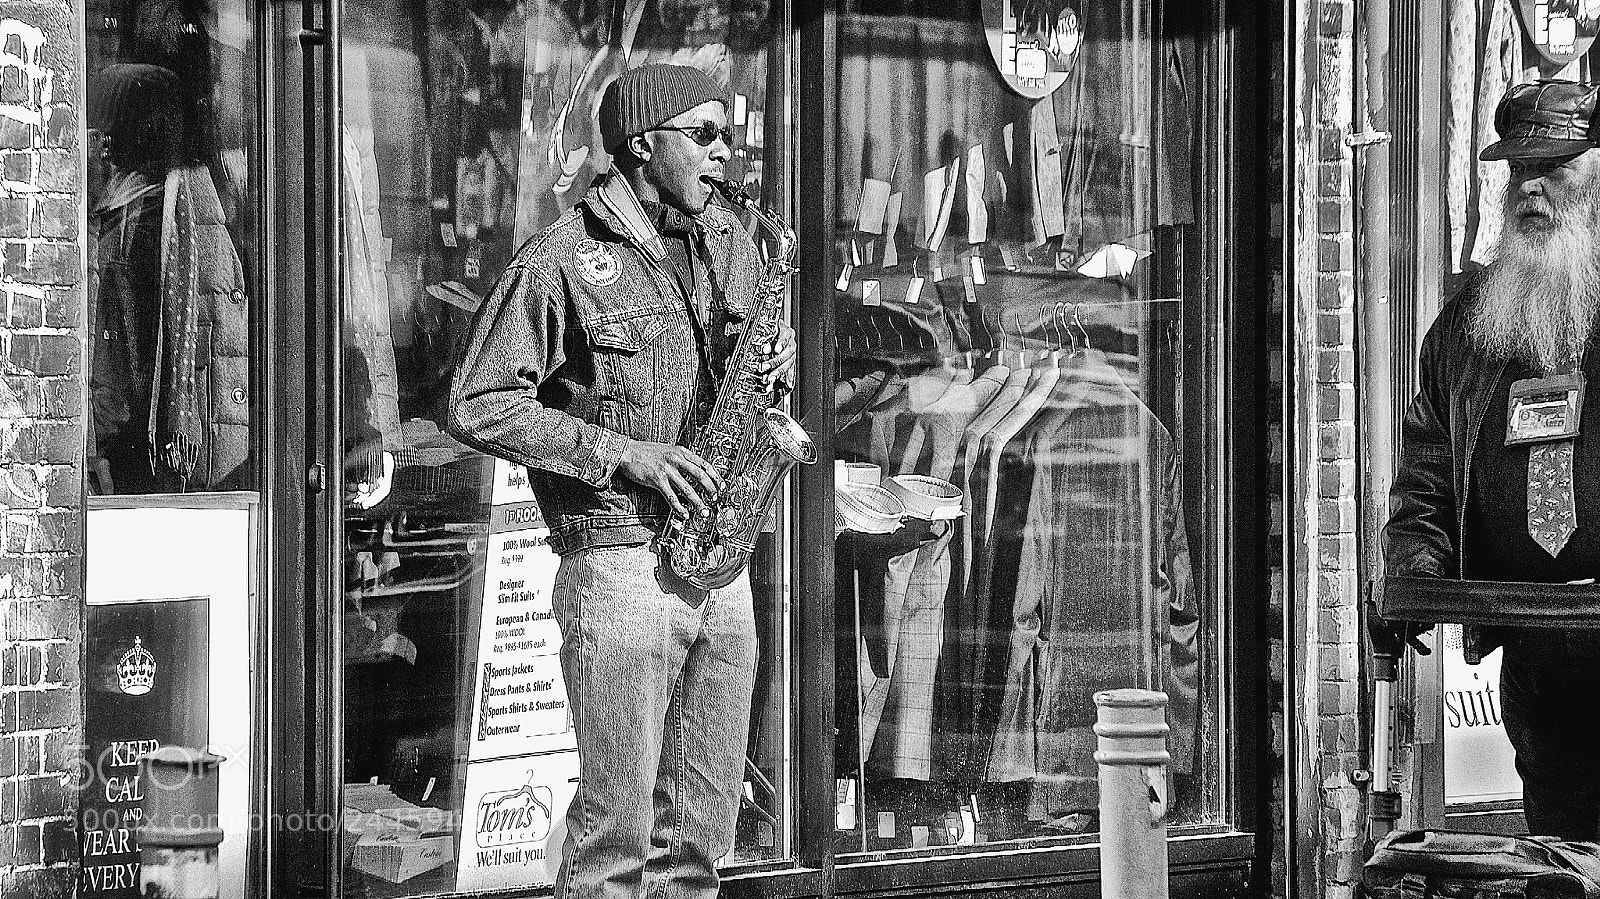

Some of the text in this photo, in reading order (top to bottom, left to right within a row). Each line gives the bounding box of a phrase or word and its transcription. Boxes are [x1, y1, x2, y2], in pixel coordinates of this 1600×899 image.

[507, 471, 526, 490] helps
[502, 540, 519, 551] 100%
[519, 535, 537, 549] Wool
[499, 578, 525, 592] Designer
[497, 592, 511, 604] Slim
[511, 591, 519, 603] Fit
[495, 614, 524, 627] European
[524, 611, 531, 622] &
[491, 662, 534, 680] Sports Jackets
[489, 686, 506, 697] Dress
[507, 684, 525, 695] Pants
[525, 682, 532, 693] &
[487, 699, 565, 719] Sports Shirts & Sweaters
[1444, 673, 1502, 729] suit
[486, 724, 521, 737] Outerwear
[105, 775, 144, 803] CAL
[122, 807, 143, 822] AND
[477, 797, 536, 834] Tom's
[476, 848, 502, 868] We'll
[503, 846, 522, 865] suit
